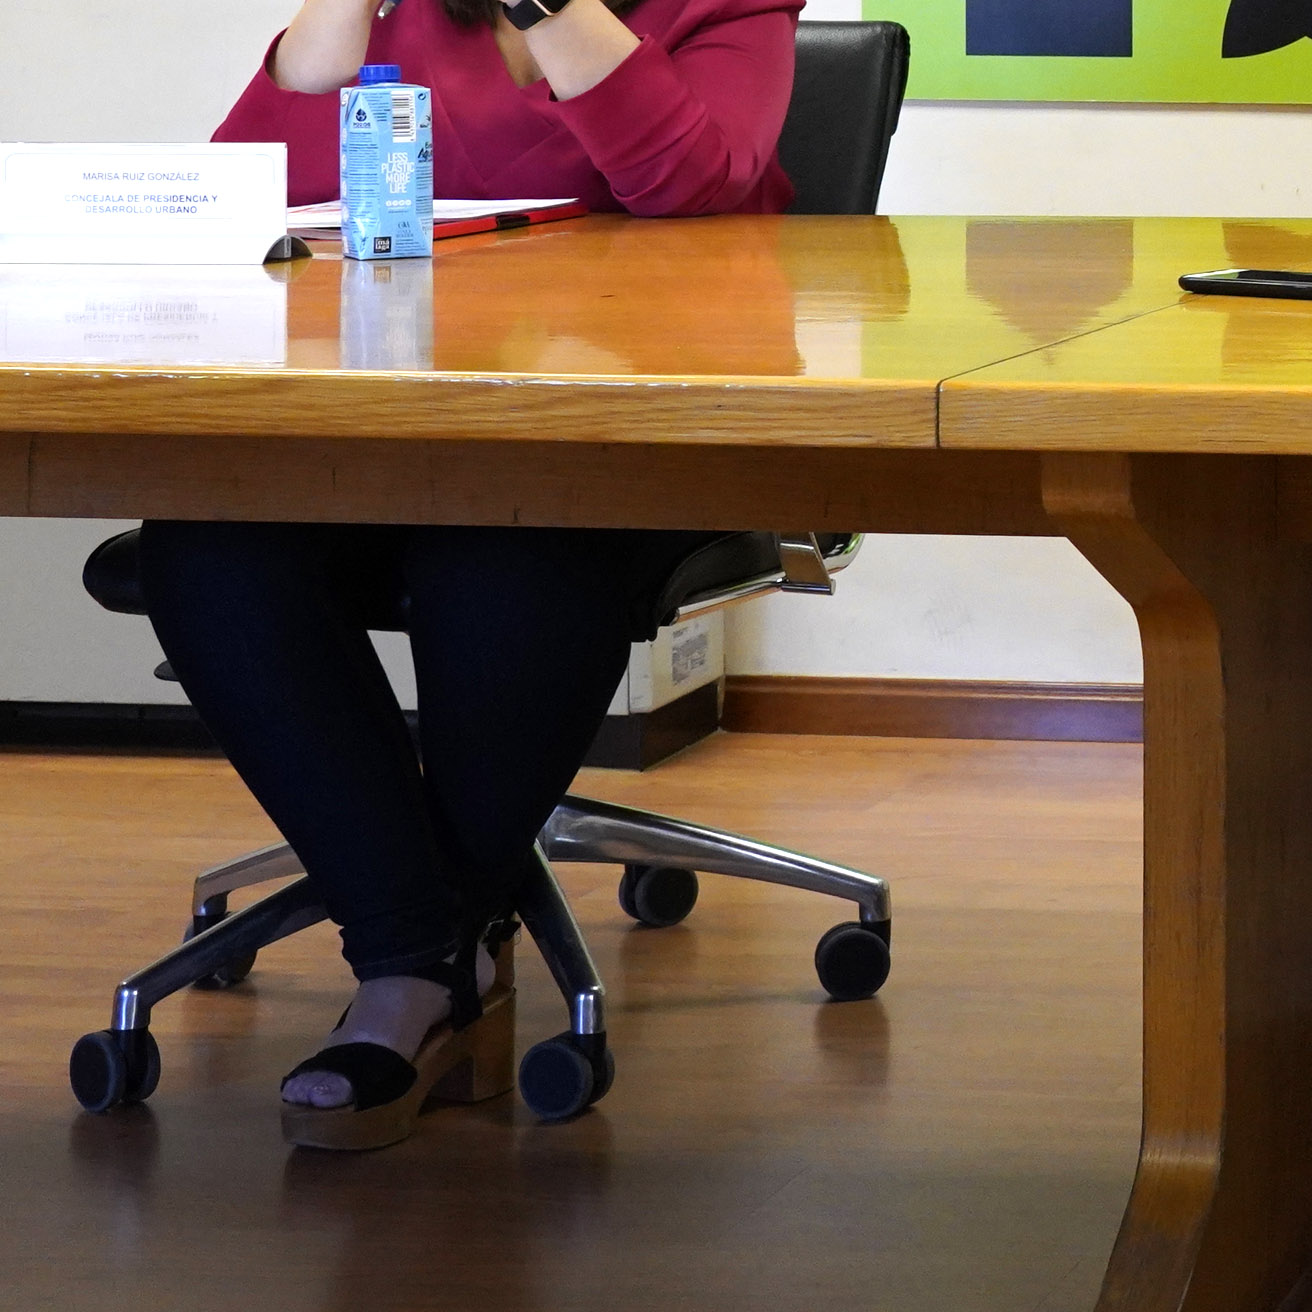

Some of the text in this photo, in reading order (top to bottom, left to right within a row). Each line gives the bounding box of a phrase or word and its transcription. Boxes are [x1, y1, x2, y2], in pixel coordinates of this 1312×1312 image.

[387, 152, 408, 163] LESS
[381, 162, 415, 174] PLASTIC
[83, 171, 200, 181] MARISA RUIZ GONZÁLEZ
[385, 172, 411, 184] MORE
[389, 183, 407, 194] LIFE
[65, 195, 218, 203] CONCEJALA DE PRESIDENCIA Y
[85, 206, 197, 214] DESARROLLO URBANO
